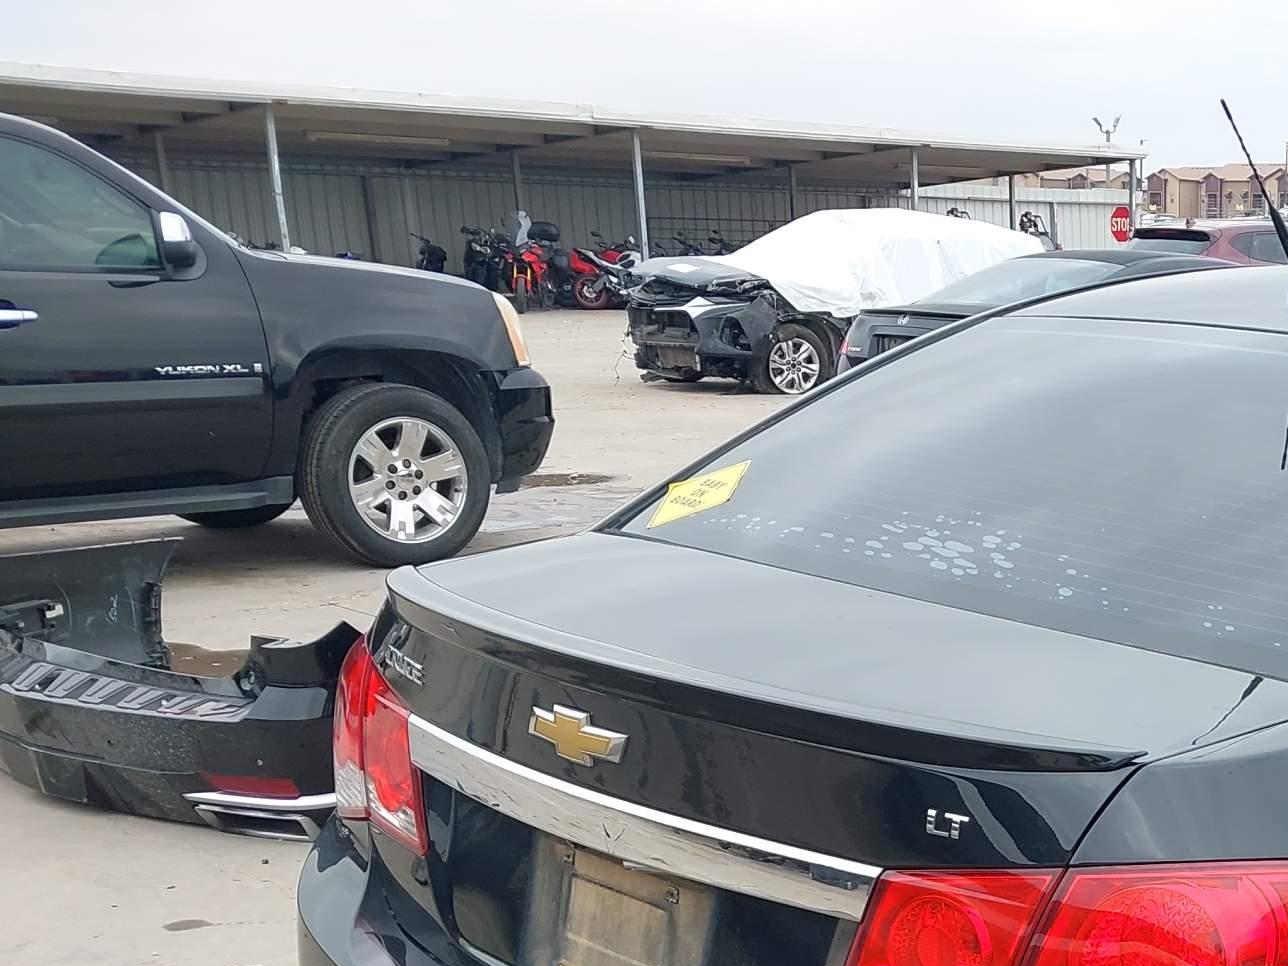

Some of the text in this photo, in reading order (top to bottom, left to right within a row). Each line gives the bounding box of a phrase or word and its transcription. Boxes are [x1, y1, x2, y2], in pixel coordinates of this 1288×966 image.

[155, 364, 249, 375] YUKON XL
[700, 479, 728, 489] BABY
[690, 489, 709, 497] ON
[926, 809, 970, 839] LT
